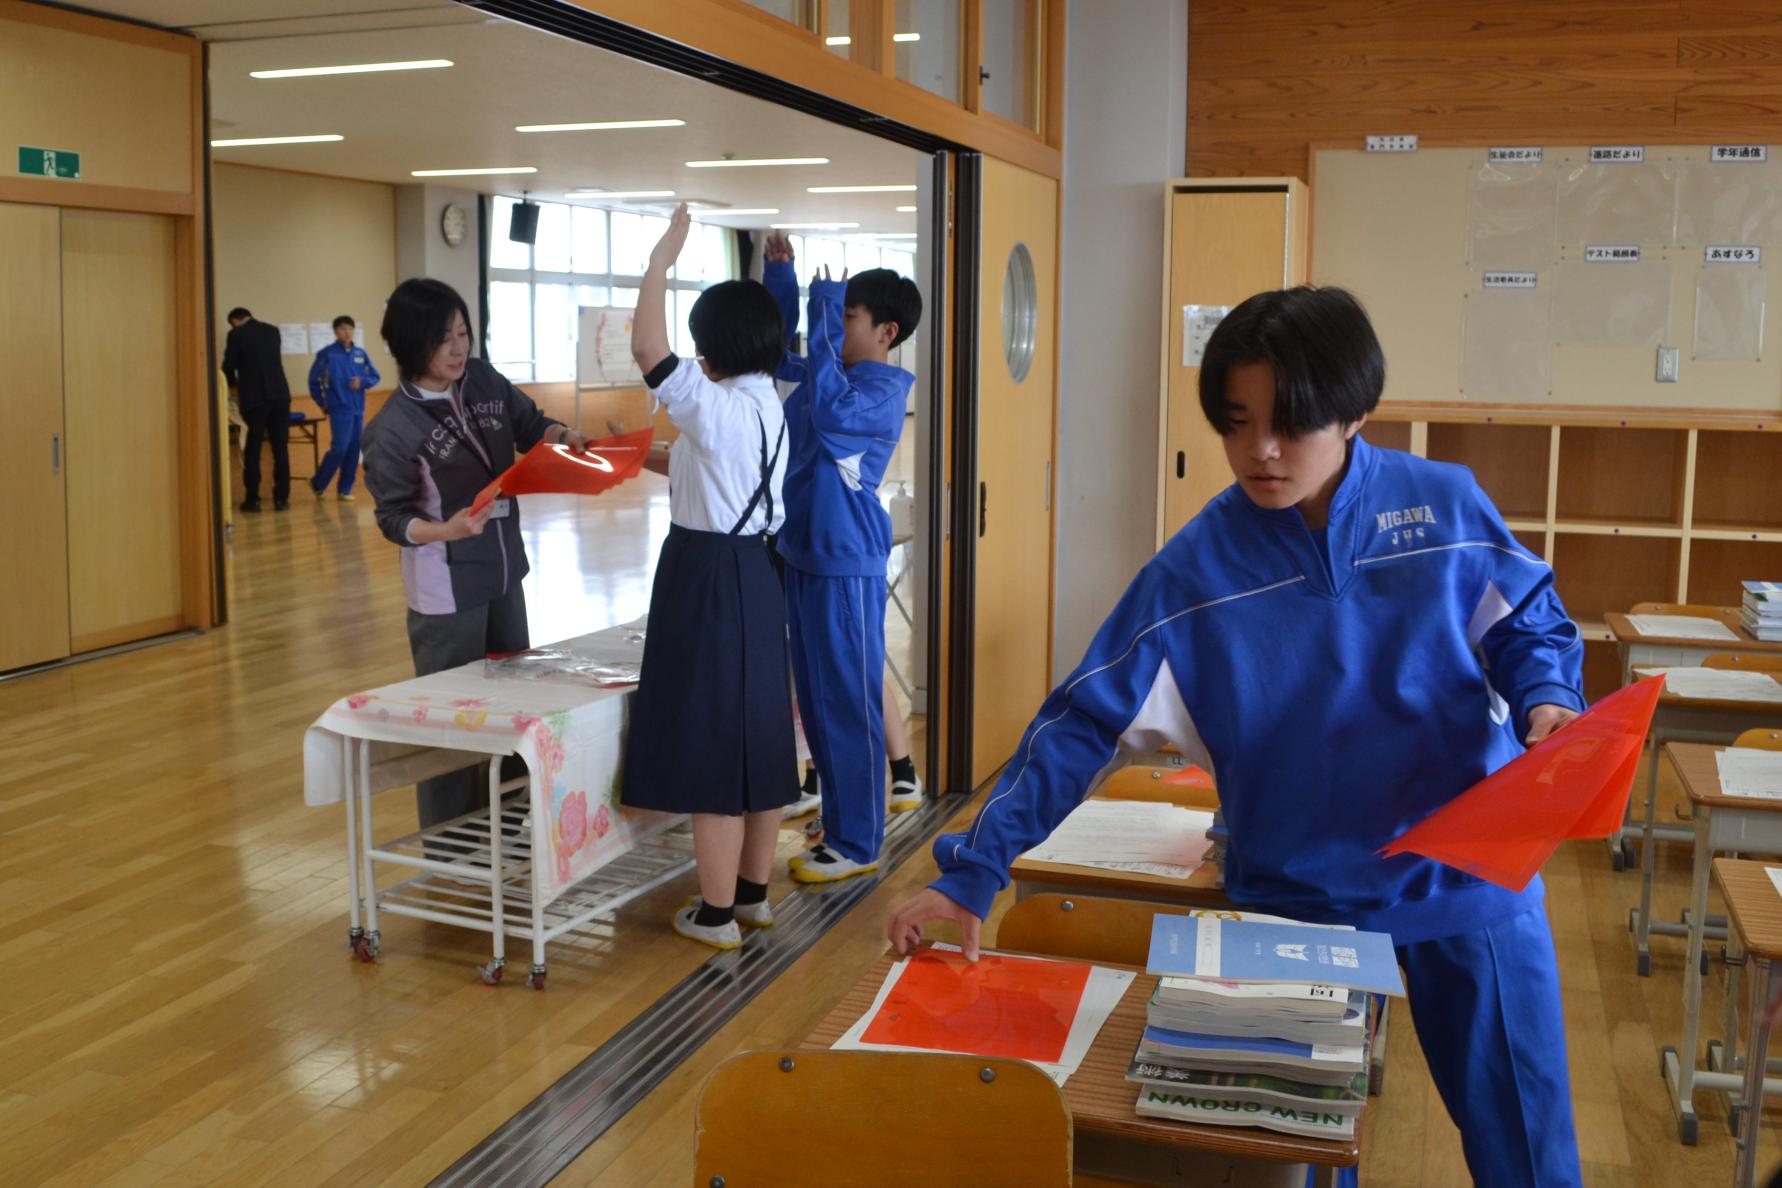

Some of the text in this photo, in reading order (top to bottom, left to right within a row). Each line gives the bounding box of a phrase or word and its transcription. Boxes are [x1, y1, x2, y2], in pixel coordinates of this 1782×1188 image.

[1717, 147, 1761, 158] 学年通信
[1711, 249, 1755, 260] あすなろ
[1376, 505, 1437, 533] MIGAWA
[1149, 1091, 1344, 1127] NEW CROWN
